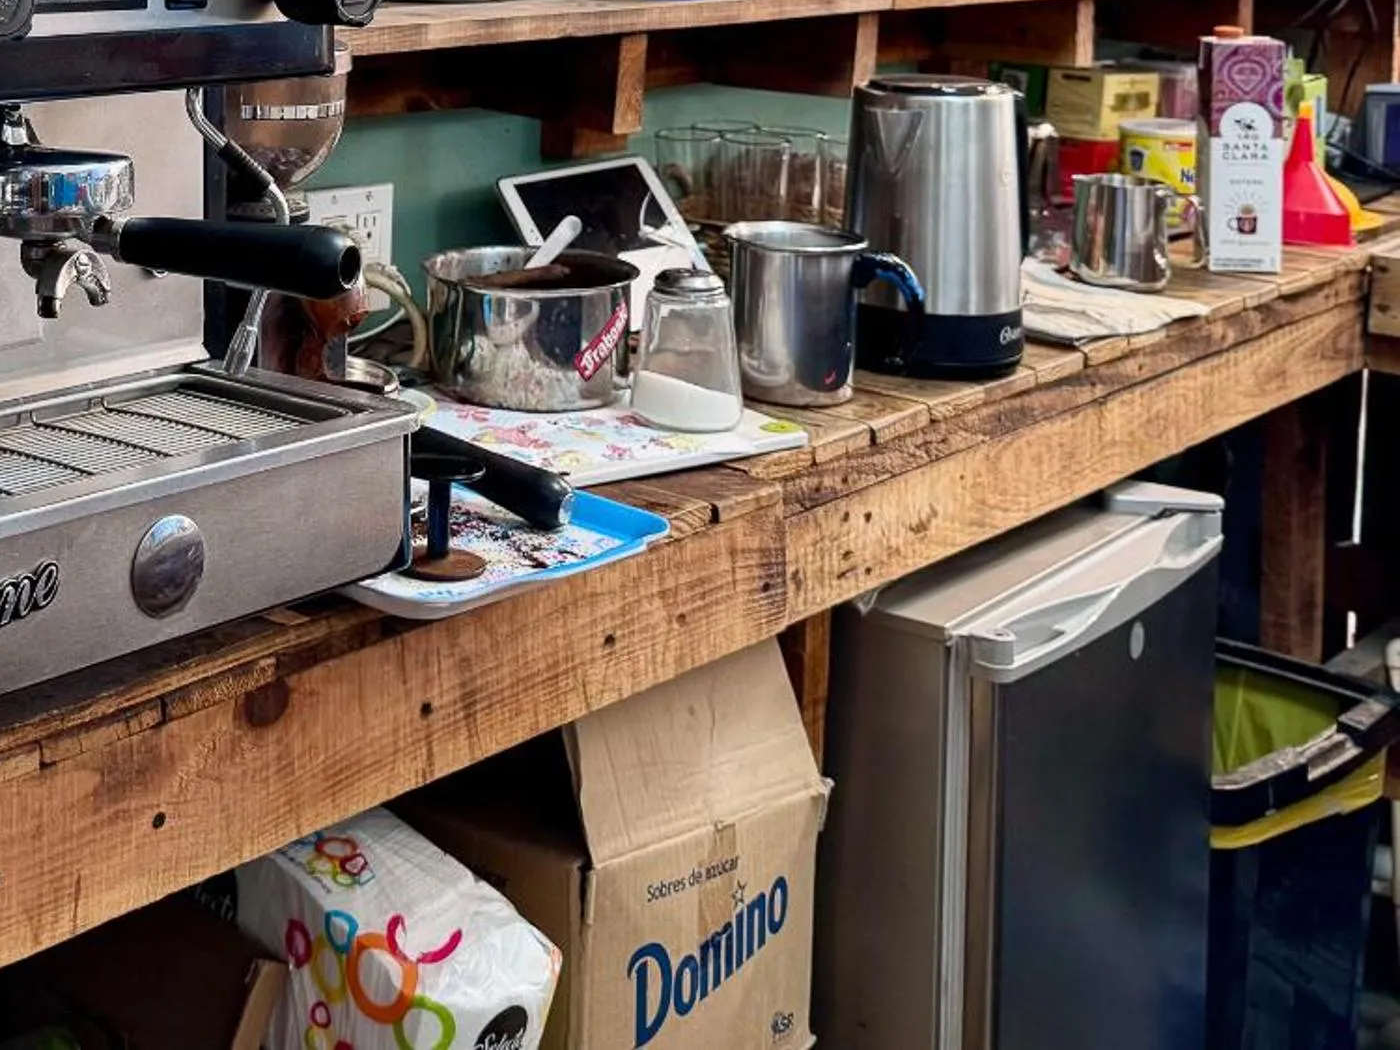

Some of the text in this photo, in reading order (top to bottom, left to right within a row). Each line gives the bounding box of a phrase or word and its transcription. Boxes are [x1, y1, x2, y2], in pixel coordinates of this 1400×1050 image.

[646, 879, 686, 903] Sobres
[688, 867, 703, 887] de
[626, 875, 789, 1049] Domino
